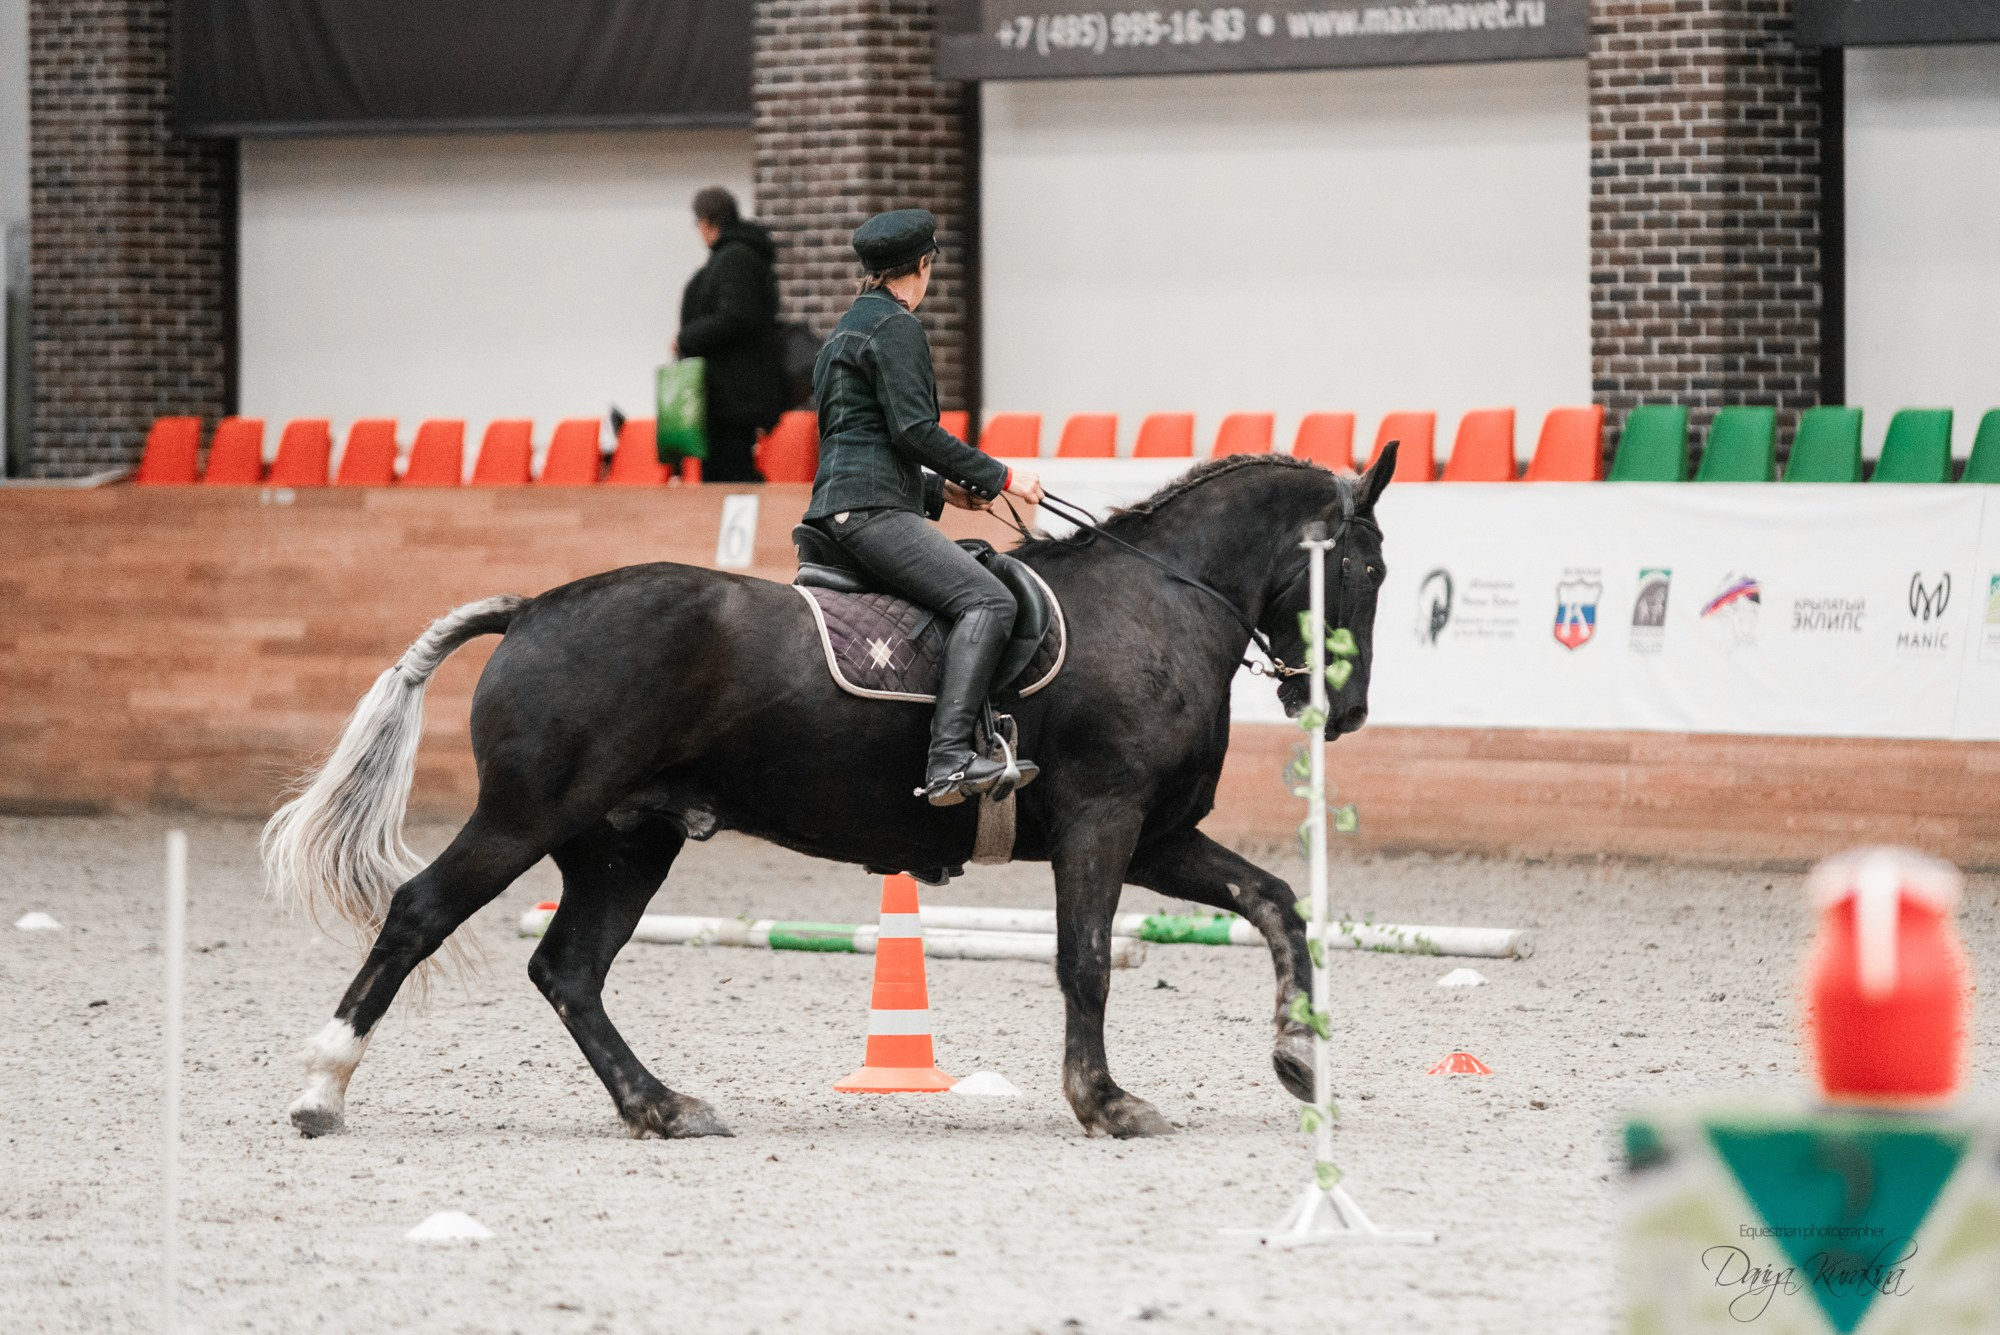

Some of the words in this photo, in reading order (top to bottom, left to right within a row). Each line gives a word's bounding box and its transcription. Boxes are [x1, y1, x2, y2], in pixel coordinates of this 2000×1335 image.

[996, 15, 1034, 50] +7
[1287, 0, 1546, 38] www.maximavet.ru
[724, 503, 750, 560] 6
[1792, 611, 1864, 631] ЭКЛИПС
